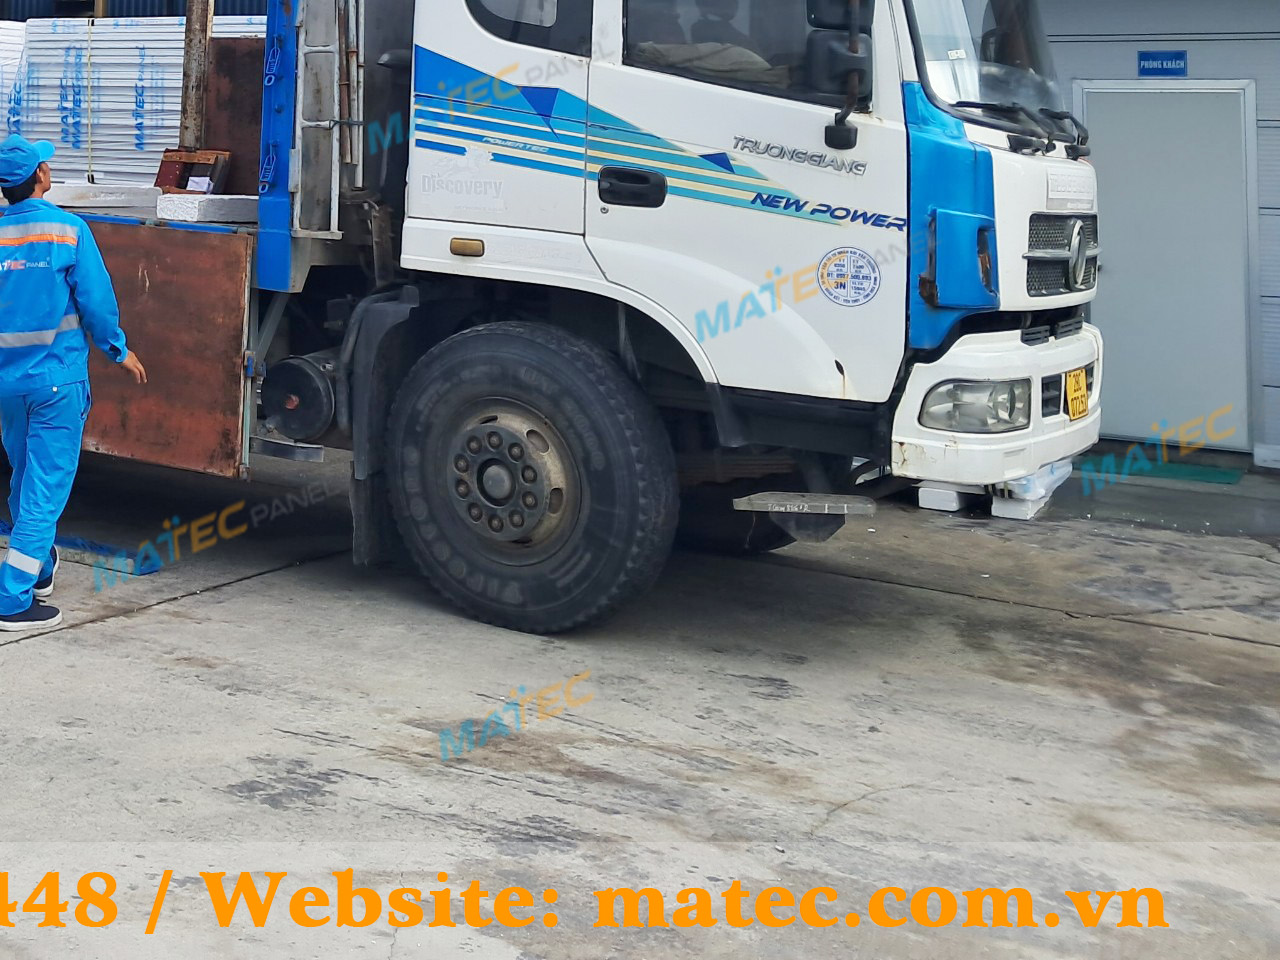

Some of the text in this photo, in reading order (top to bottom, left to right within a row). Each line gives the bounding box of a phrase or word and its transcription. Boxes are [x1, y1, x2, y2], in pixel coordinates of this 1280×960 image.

[1140, 58, 1185, 69] PHÒNG KHÁCH
[58, 78, 69, 142] MATEC
[70, 83, 82, 149] MATEC
[132, 84, 145, 150] MATEC
[421, 174, 503, 199] Discovery
[750, 192, 907, 232] NEW POWER
[833, 281, 846, 290] 3N
